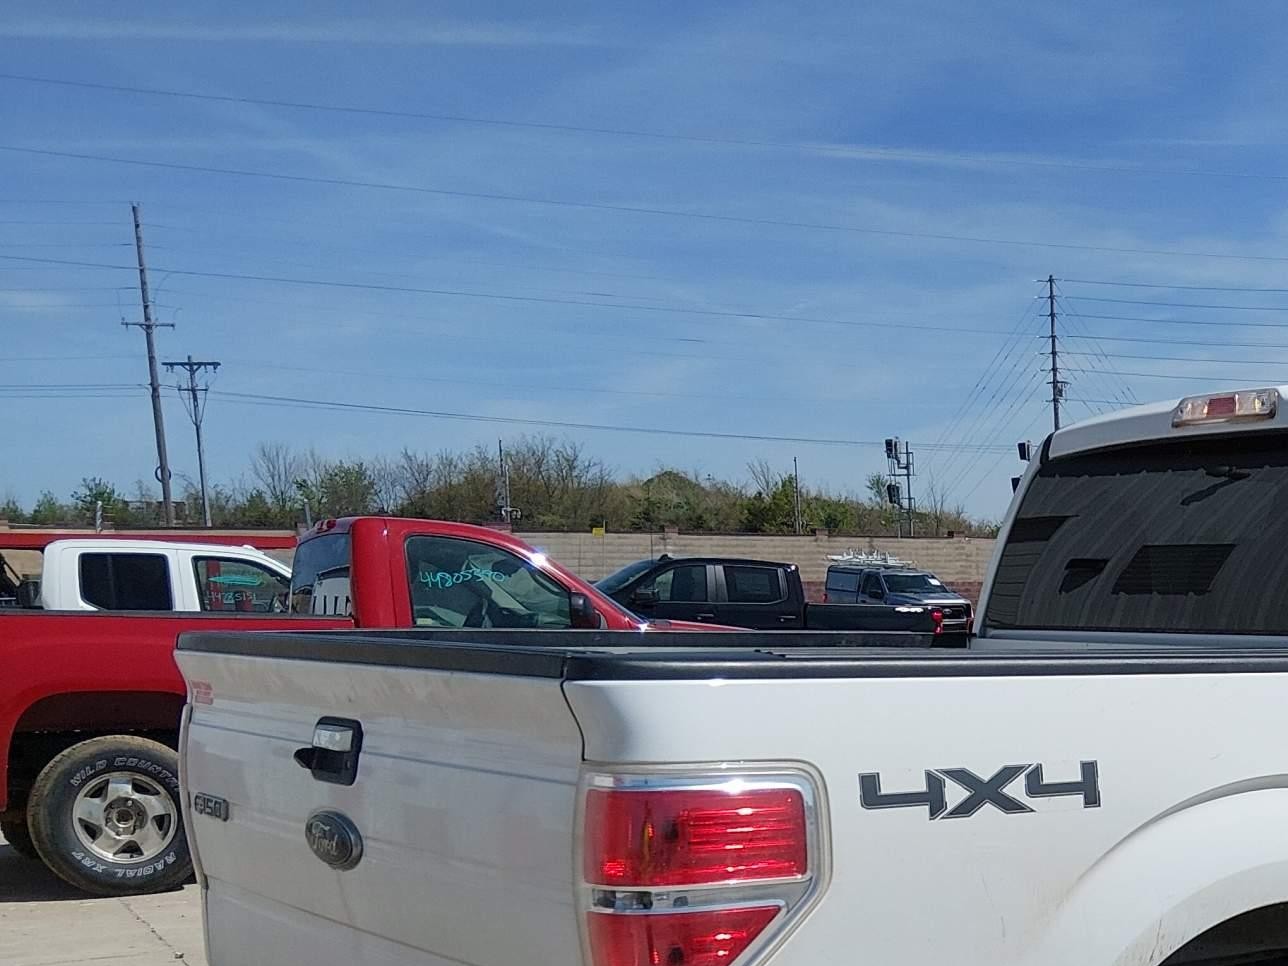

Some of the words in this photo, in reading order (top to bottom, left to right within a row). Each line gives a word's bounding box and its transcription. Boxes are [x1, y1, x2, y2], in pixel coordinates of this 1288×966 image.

[70, 759, 107, 787] WILD
[311, 821, 338, 856] Ford
[71, 851, 109, 873] XRT
[114, 852, 177, 877] RADIAL
